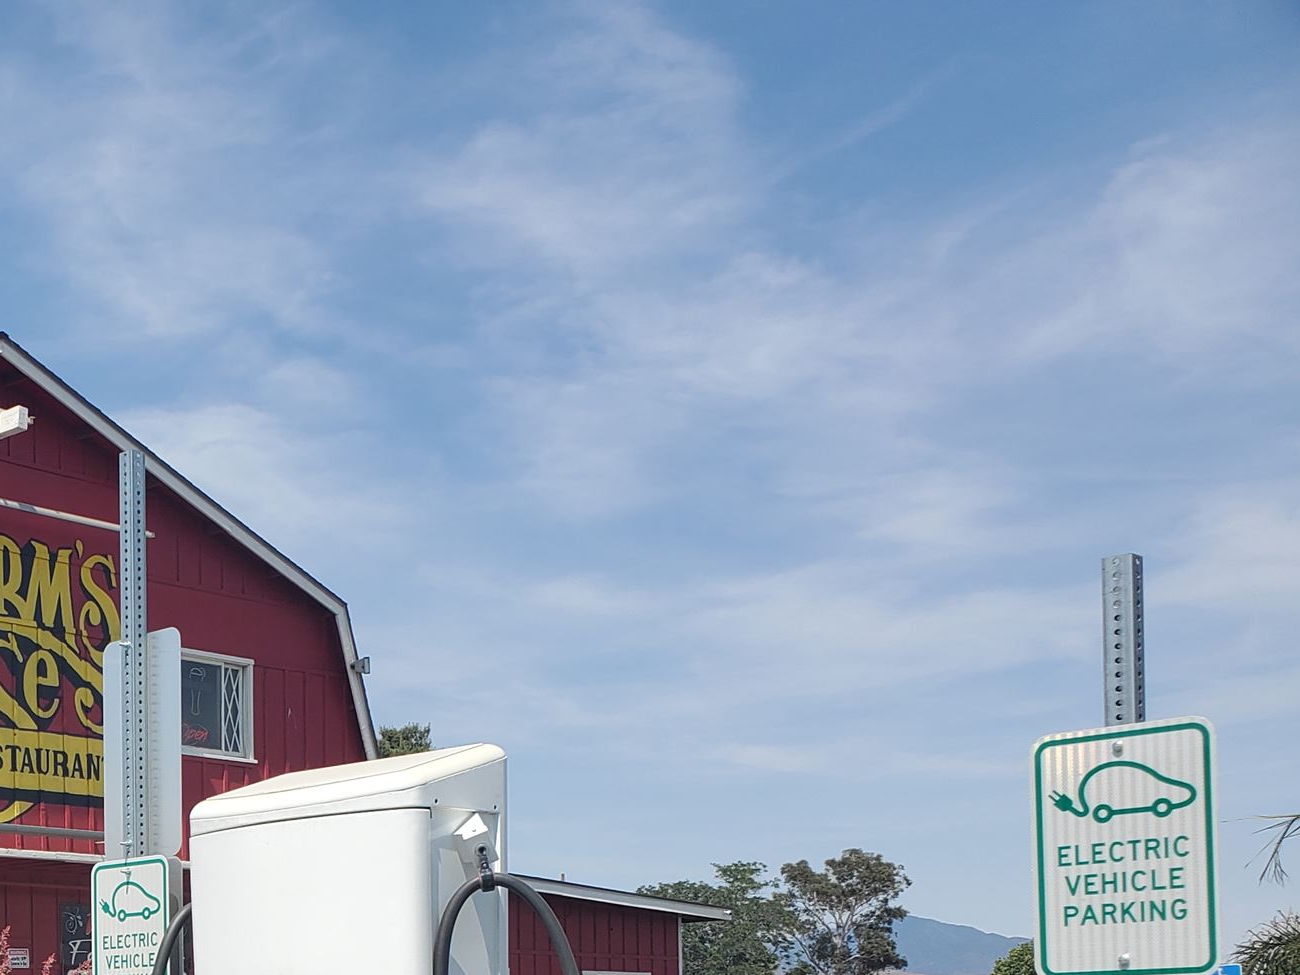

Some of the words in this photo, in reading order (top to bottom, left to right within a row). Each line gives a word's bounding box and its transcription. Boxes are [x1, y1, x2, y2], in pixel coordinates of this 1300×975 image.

[1057, 835, 1190, 867] ELECTRIC
[1064, 867, 1186, 896] VEHICLE
[1063, 898, 1188, 927] PARKING
[102, 931, 159, 951] ELECTRIC
[105, 952, 156, 970] VEHICLE
